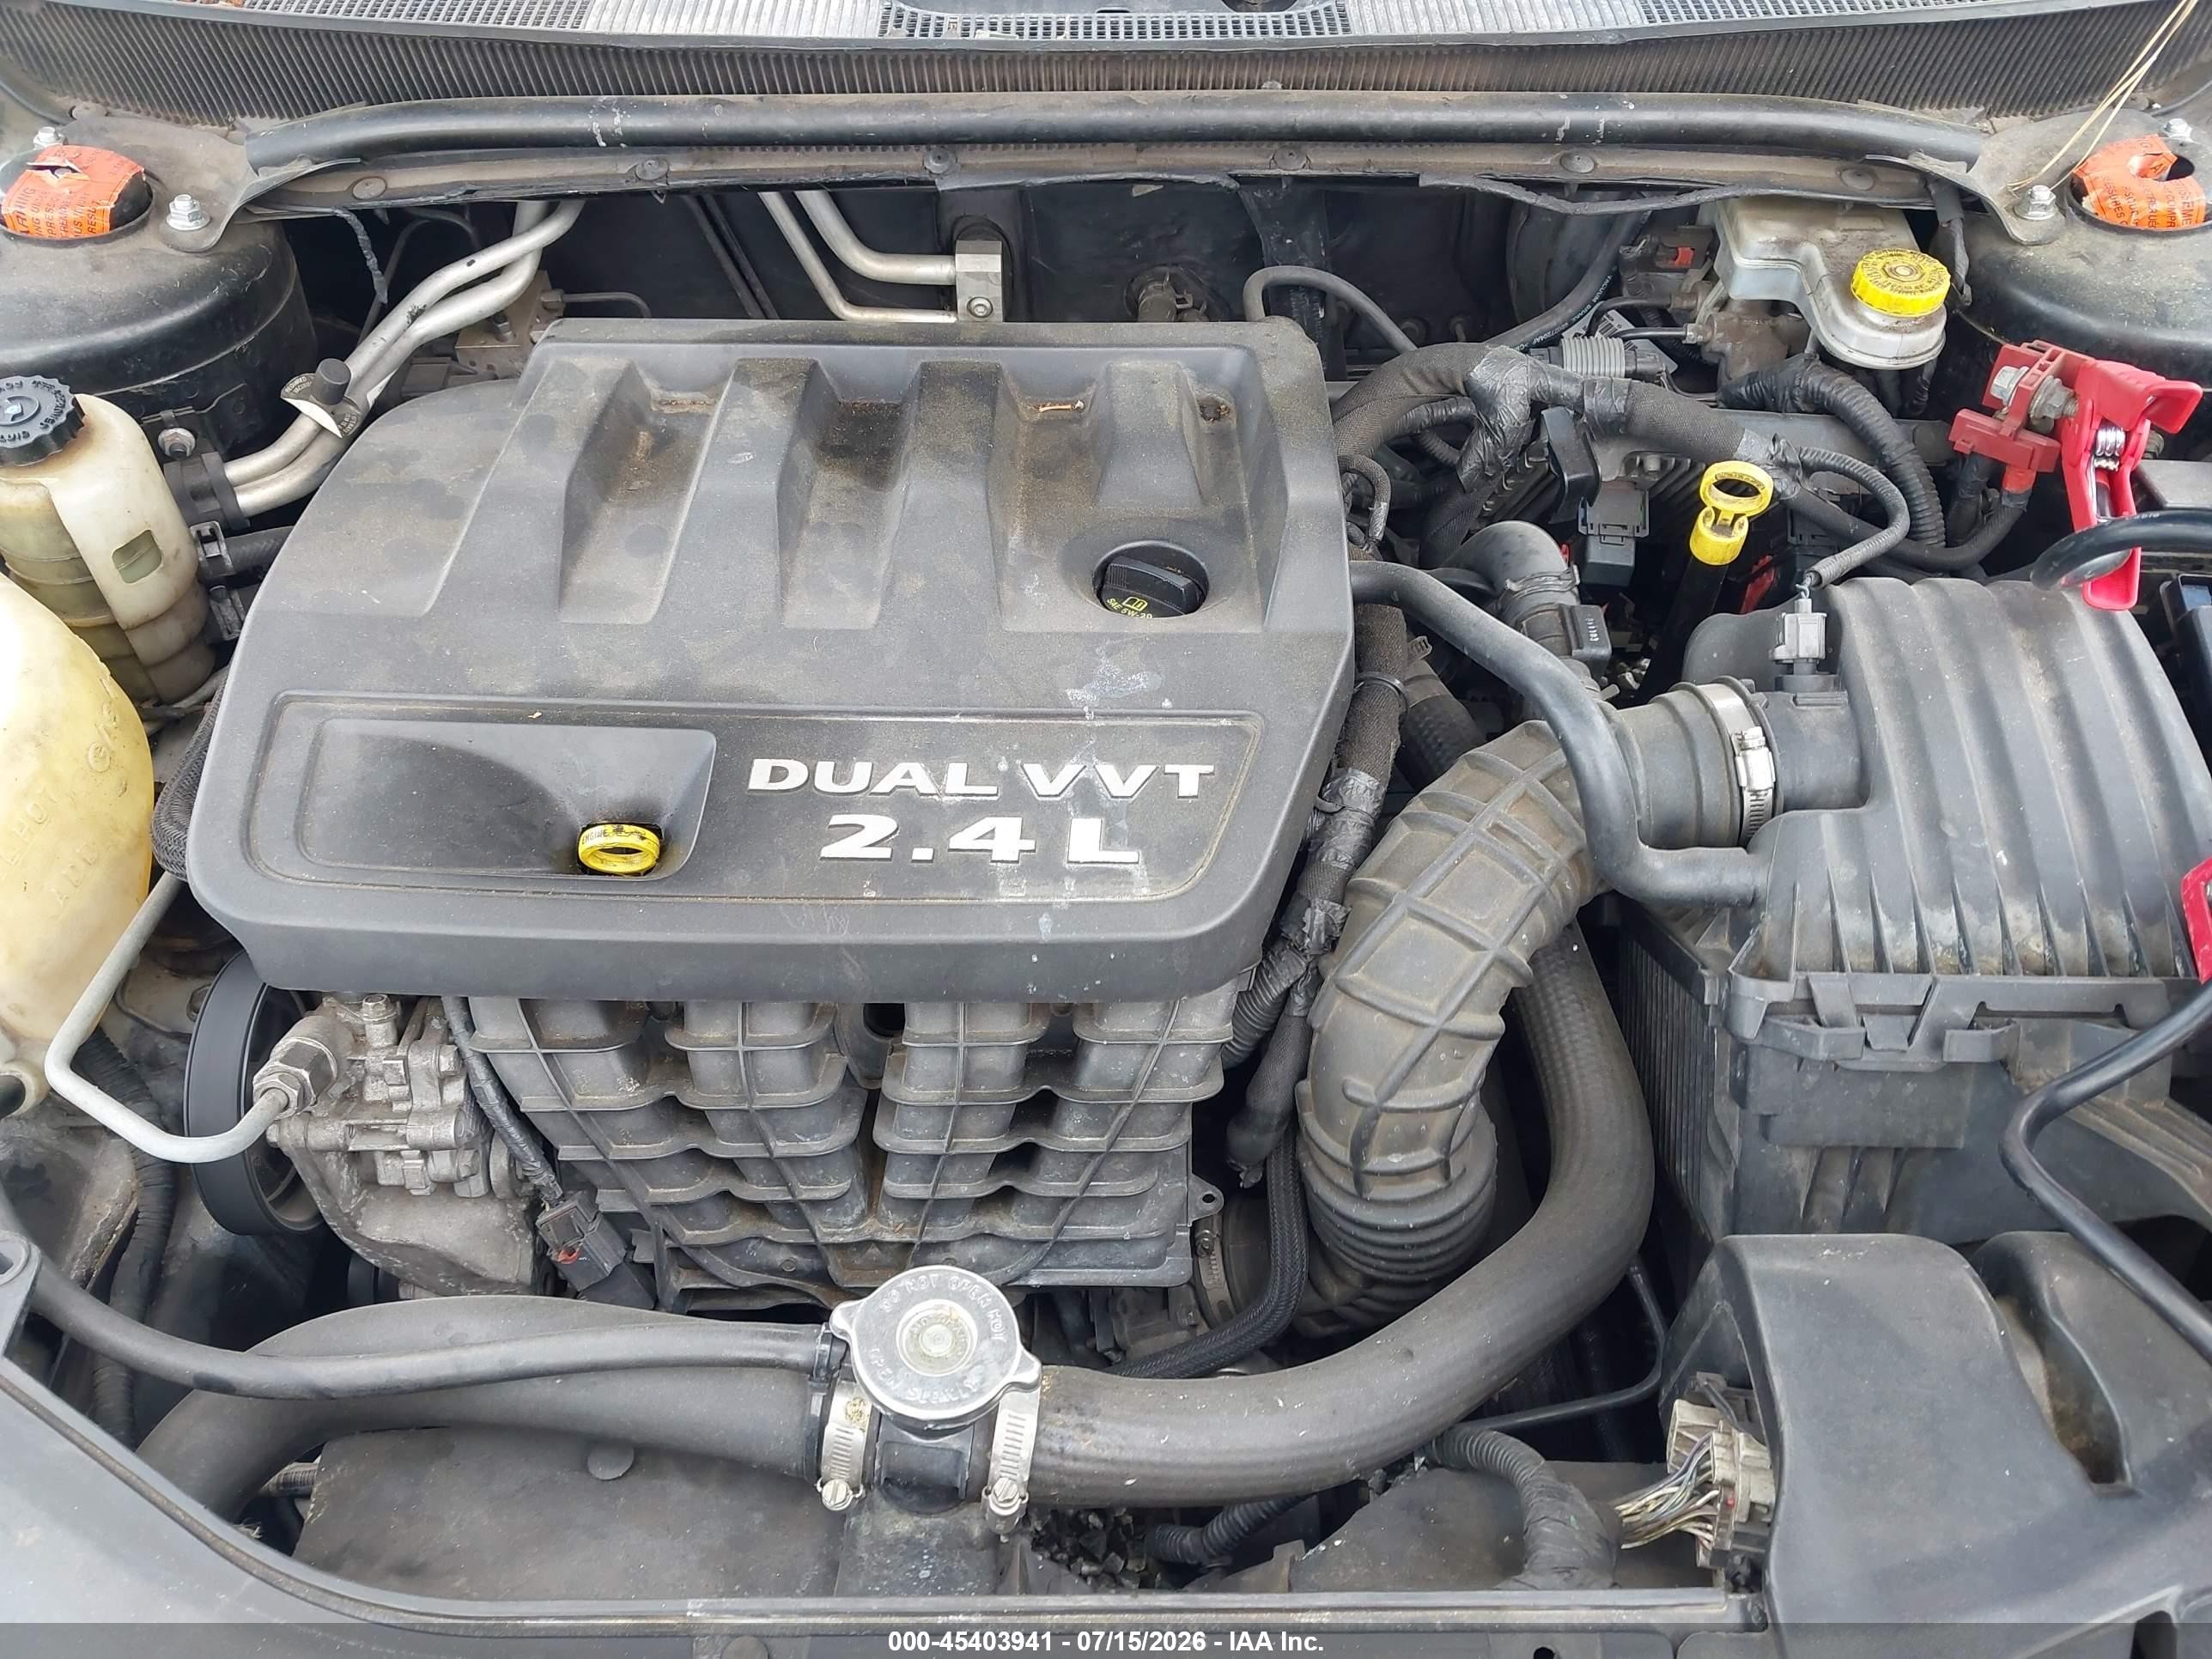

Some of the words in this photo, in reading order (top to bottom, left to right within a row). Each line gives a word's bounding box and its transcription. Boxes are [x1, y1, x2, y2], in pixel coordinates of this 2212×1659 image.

[1106, 598, 1123, 611] SAE
[1121, 608, 1153, 618] 5W-20
[747, 758, 1000, 798] DUAL
[1021, 763, 1215, 799] VVT
[900, 1273, 940, 1294] NOT
[948, 1275, 993, 1310] OPEN
[988, 1309, 1008, 1343] HOT
